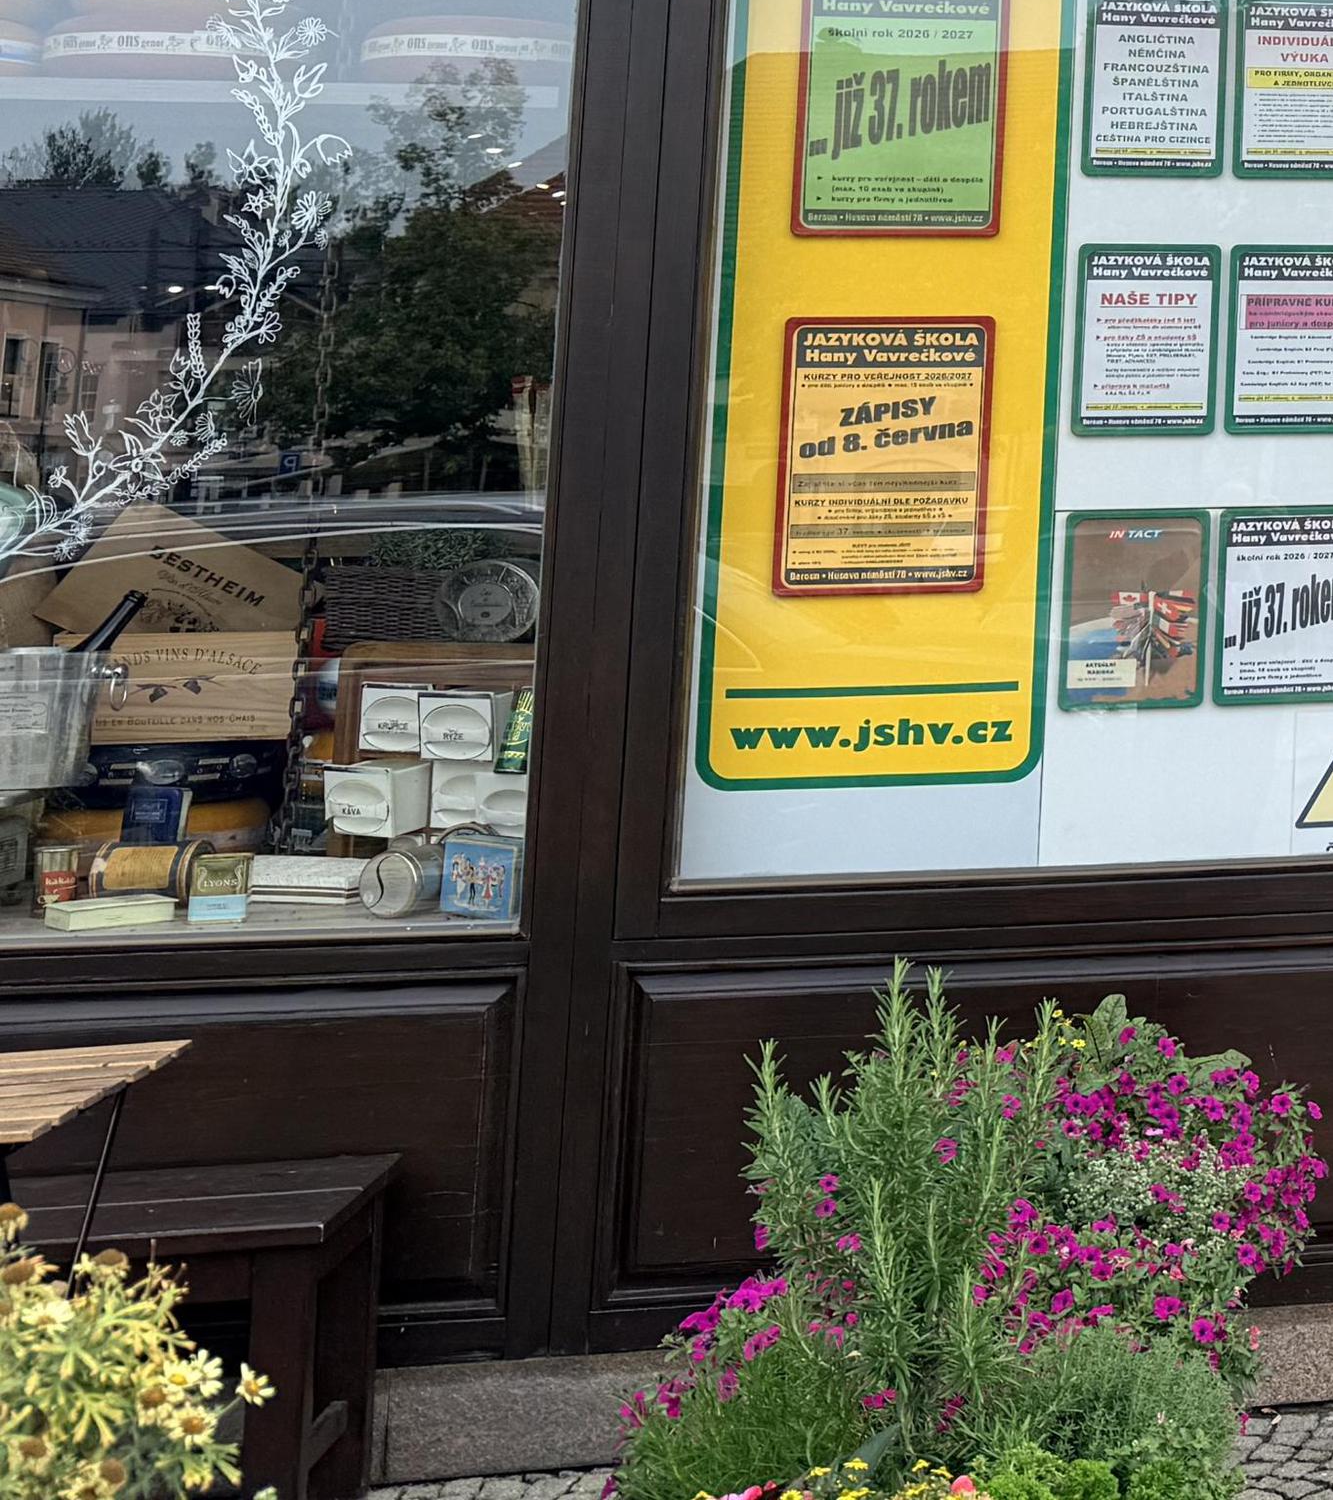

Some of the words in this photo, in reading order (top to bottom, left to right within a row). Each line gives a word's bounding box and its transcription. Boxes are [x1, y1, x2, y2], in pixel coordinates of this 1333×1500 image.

[879, 0, 990, 15] Vavrečkové
[872, 28, 893, 38] rok
[897, 29, 930, 39] 2026
[941, 30, 973, 39] 2027
[1118, 33, 1195, 45] ANGLIČTINA
[1128, 48, 1186, 59] NĚMČINA
[1281, 51, 1329, 63] VÝUKA
[1104, 62, 1209, 74] FRANCOUZŠTINA
[1112, 75, 1199, 88] ŠPANĚLŠTINA
[1123, 91, 1188, 102] ITALŠTINA
[831, 71, 866, 160] již
[868, 68, 903, 145] 37.
[908, 60, 991, 136] rokem
[1102, 106, 1208, 117] PORTUGALŠTINA
[1110, 120, 1198, 132] HEBREJŠTINA
[1144, 135, 1165, 143] PRO
[1092, 255, 1162, 265] JAZYKOVÁ
[1166, 254, 1210, 265] ŠKOLA
[1093, 267, 1128, 279] Hany
[1132, 267, 1208, 277] Vavrečkové
[1101, 291, 1150, 305] NAŠE
[1156, 293, 1198, 305] TIPY
[804, 328, 909, 347] JAZYKOVÁ
[914, 329, 979, 346] ŠKOLA
[805, 349, 857, 364] Hany
[864, 348, 976, 362] Vavrečkové
[864, 371, 921, 380] VEŘEJNOST
[839, 396, 937, 427] ZÁPISY
[800, 436, 836, 459] od
[842, 434, 867, 453] 8.
[874, 420, 973, 448] června
[1109, 530, 1125, 538] IN
[1128, 529, 1162, 538] TACT
[150, 545, 266, 607] BESTHEIM
[729, 719, 1013, 752] www.jshv.cz
[203, 879, 237, 887] LYONS
